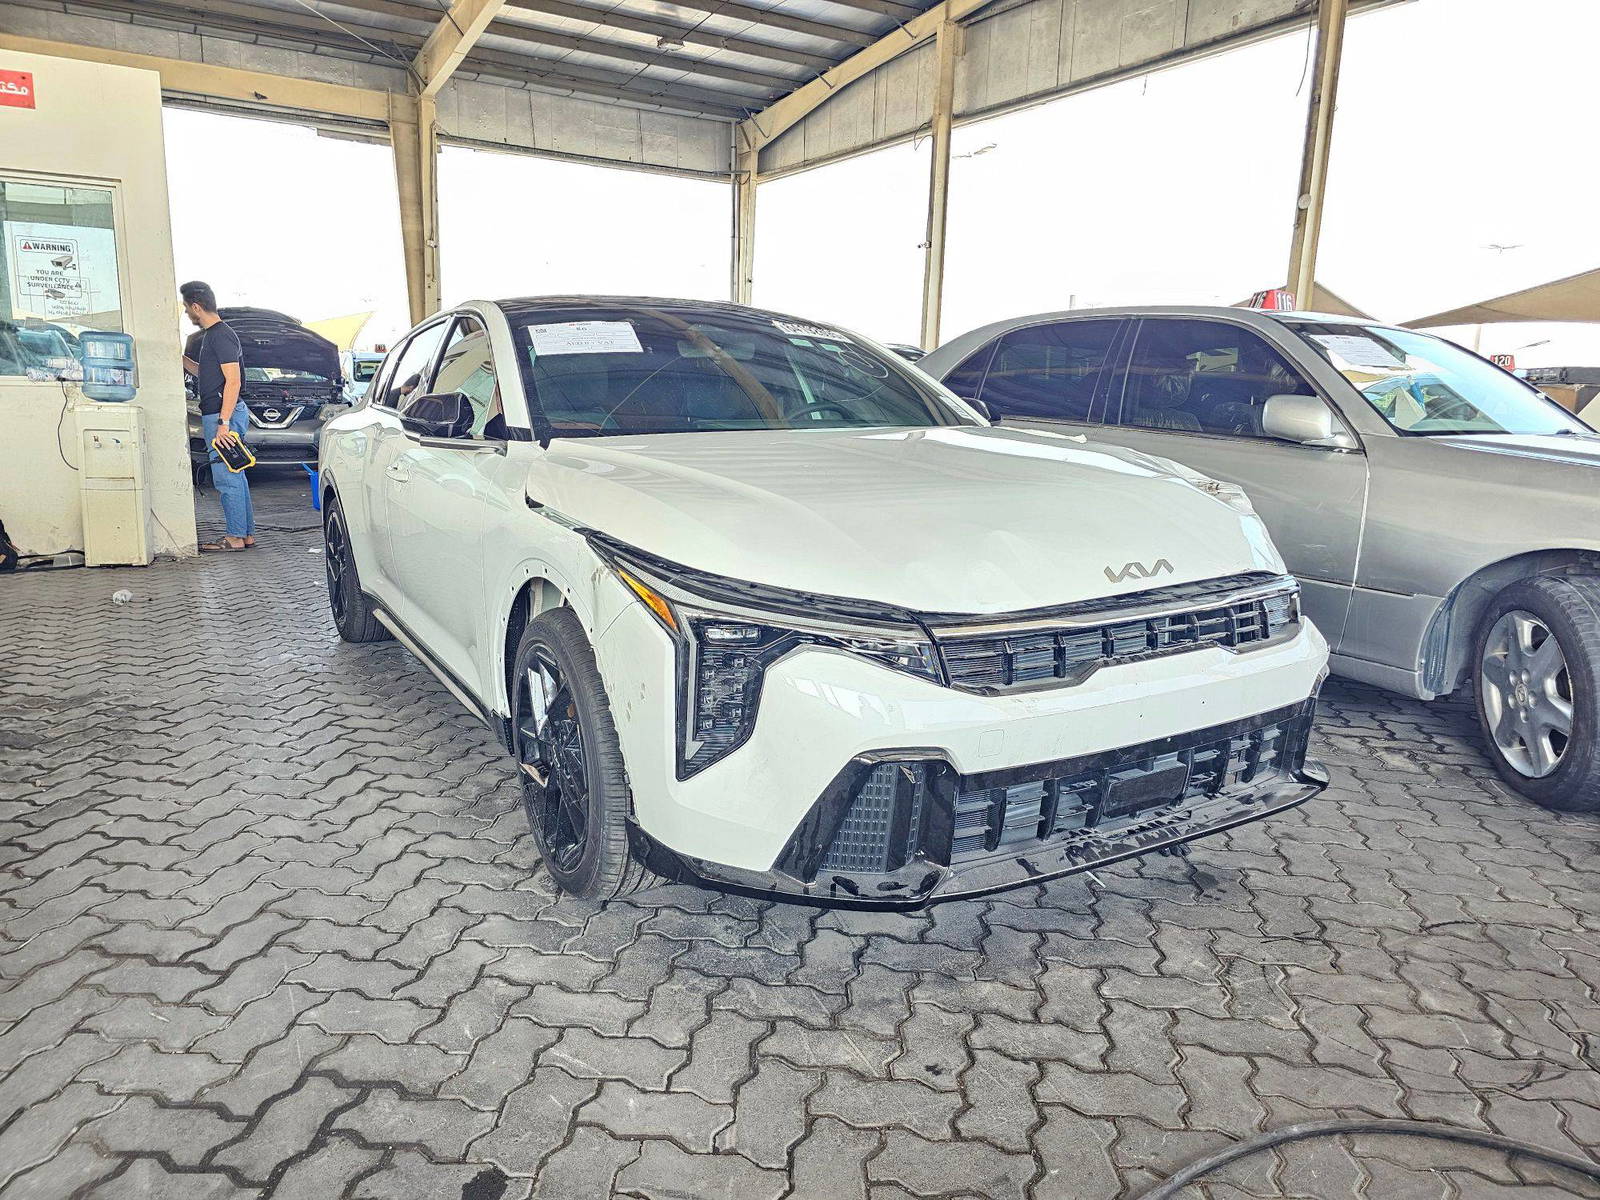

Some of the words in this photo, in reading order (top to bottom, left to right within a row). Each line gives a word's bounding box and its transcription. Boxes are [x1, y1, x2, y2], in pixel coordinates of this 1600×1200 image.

[0, 80, 28, 96] مكت
[32, 242, 71, 252] WARNING
[1277, 292, 1293, 312] 116
[1494, 355, 1511, 367] 120
